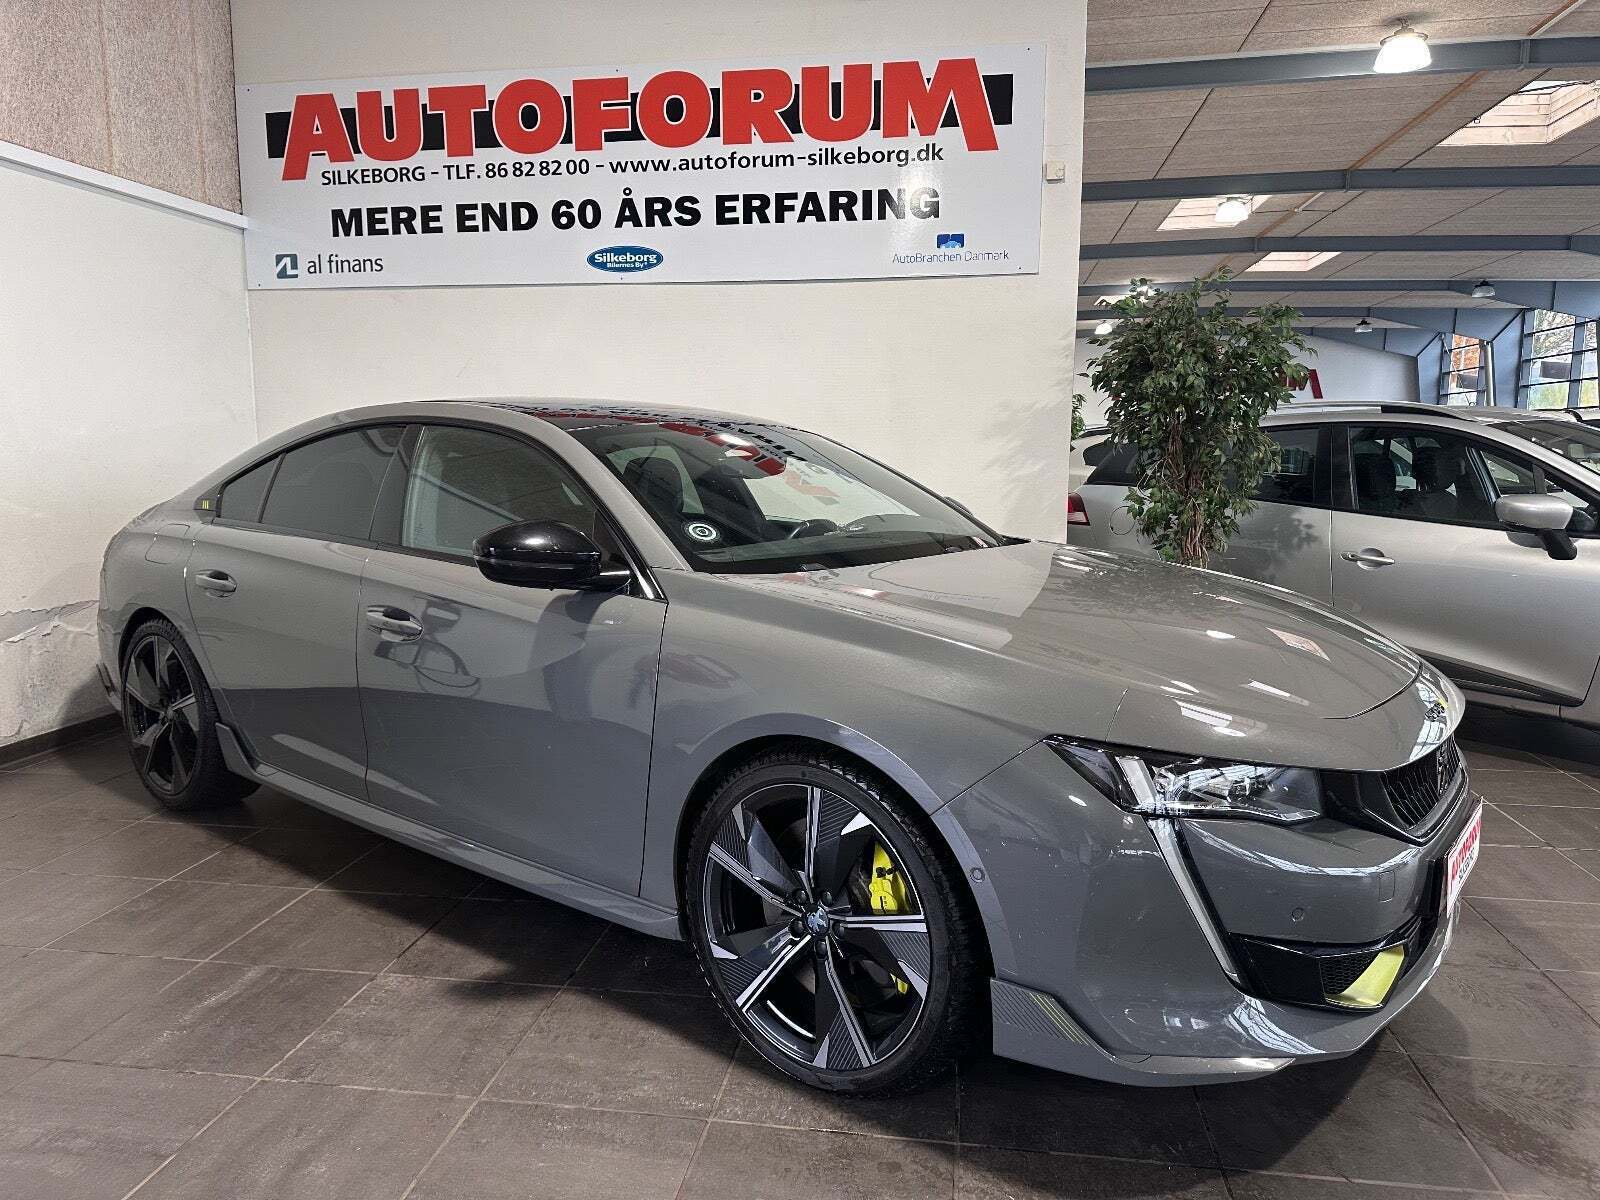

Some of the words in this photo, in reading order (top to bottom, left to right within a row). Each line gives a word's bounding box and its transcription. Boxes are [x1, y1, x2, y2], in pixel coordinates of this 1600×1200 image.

[281, 57, 999, 181] AUTOFORUM
[321, 165, 426, 186] SILKEBORG
[443, 163, 481, 181] TLF.
[608, 142, 944, 174] www.autoforum-silkeborg.dk
[330, 204, 444, 238] MERE
[455, 201, 539, 233] END
[551, 198, 602, 231] 60
[614, 187, 702, 229] ÅRS
[715, 188, 940, 226] ERFARING
[306, 253, 323, 275] al
[328, 253, 384, 274] finans
[594, 252, 658, 264] Silkeborg
[892, 251, 962, 264] AutoBranchen
[965, 250, 1009, 261] Danmark
